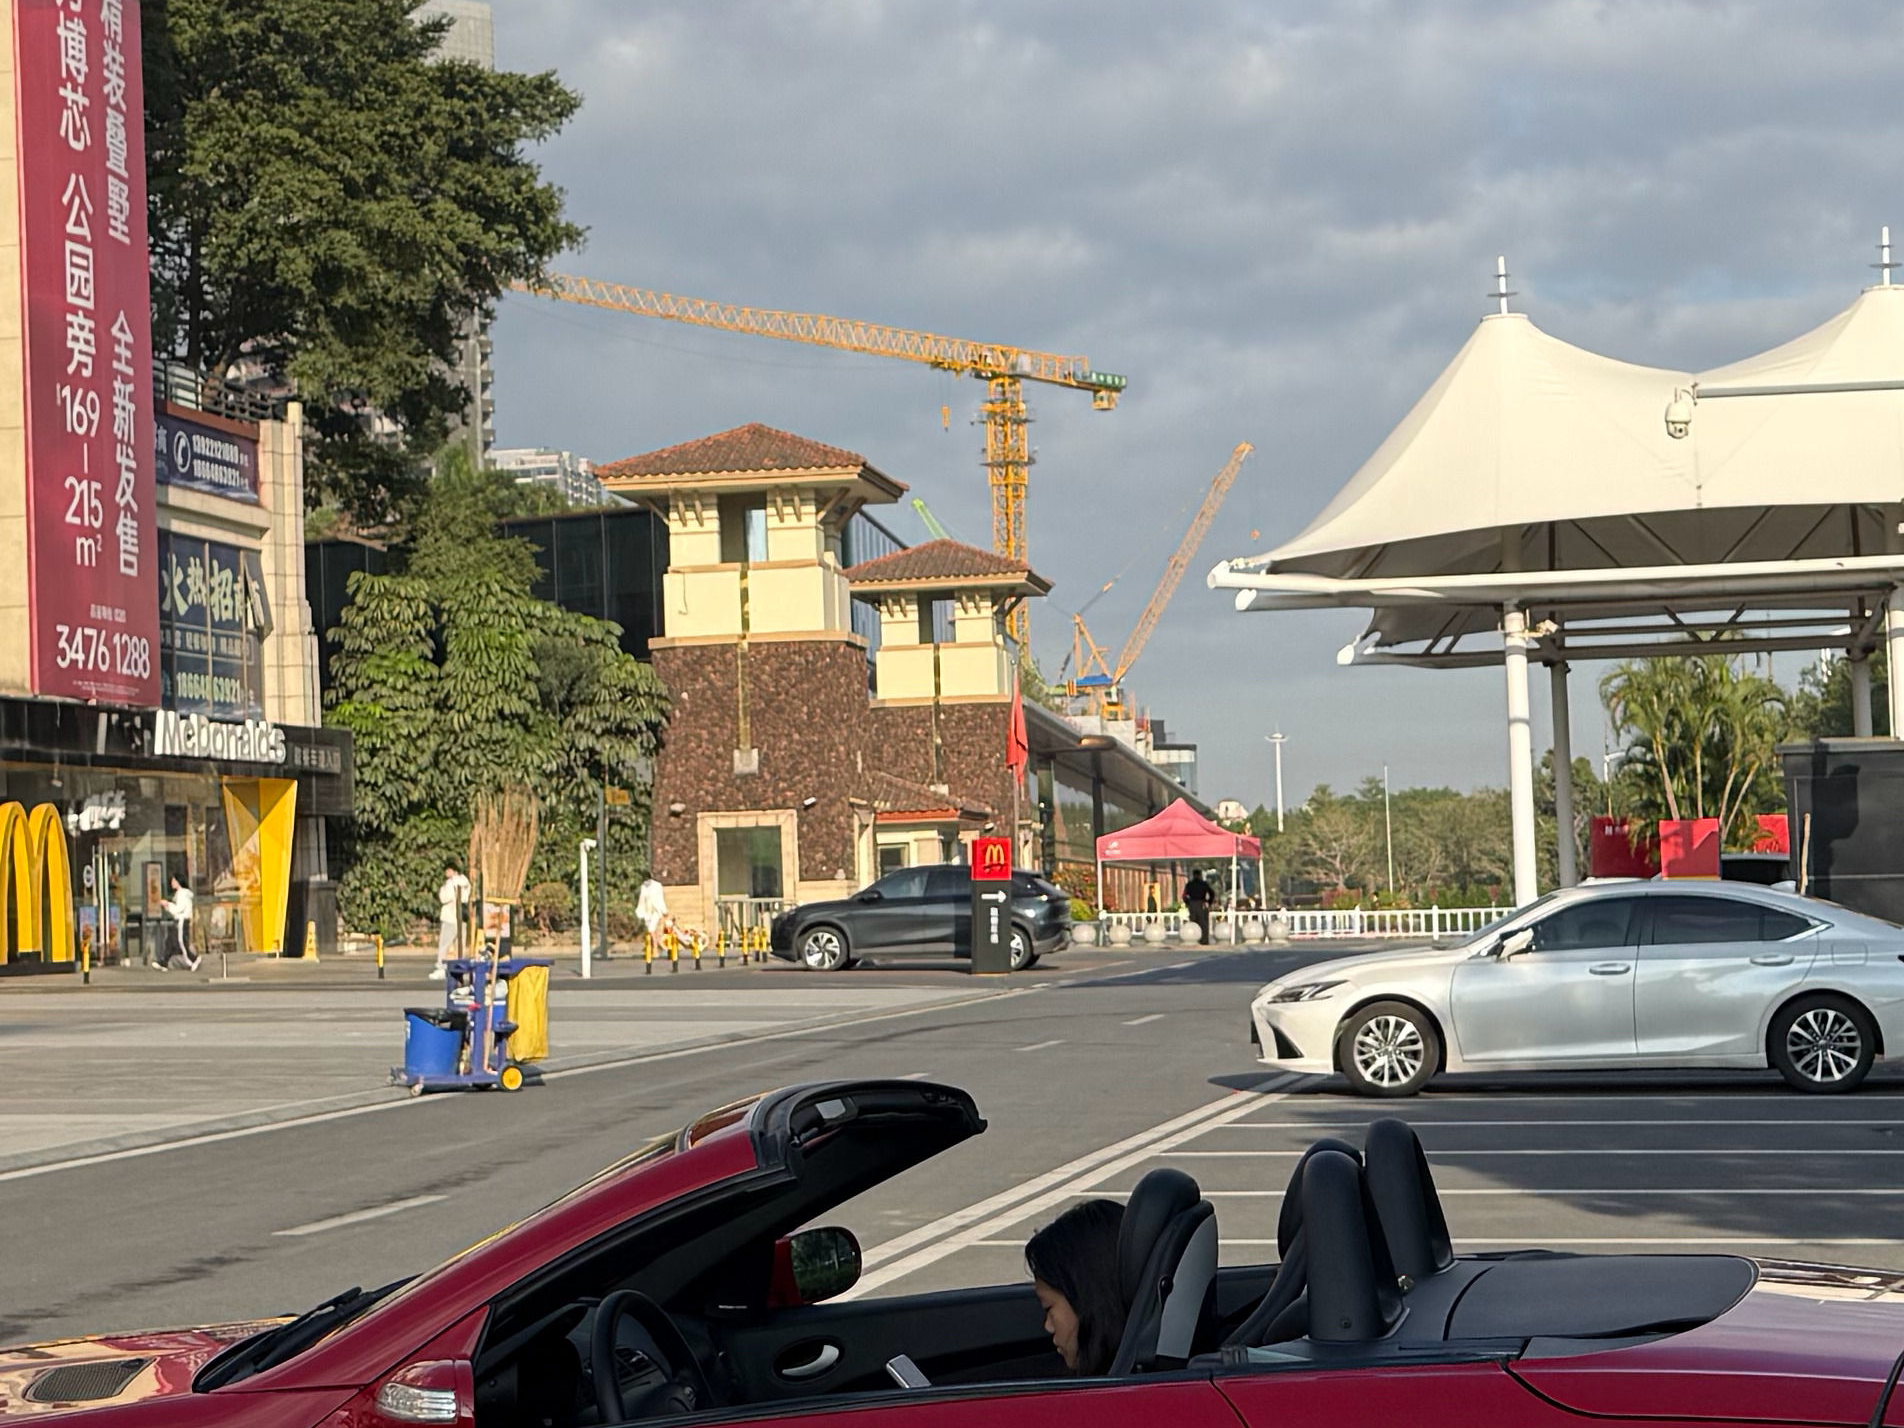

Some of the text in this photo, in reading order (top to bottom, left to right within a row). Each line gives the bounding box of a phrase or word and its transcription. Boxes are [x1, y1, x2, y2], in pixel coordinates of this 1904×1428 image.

[61, 173, 96, 378] 公园旁
[62, 385, 100, 437] 169
[111, 310, 139, 577] 全新发售
[65, 476, 103, 529] 215
[56, 624, 109, 672] 3476
[113, 632, 150, 679] 1288
